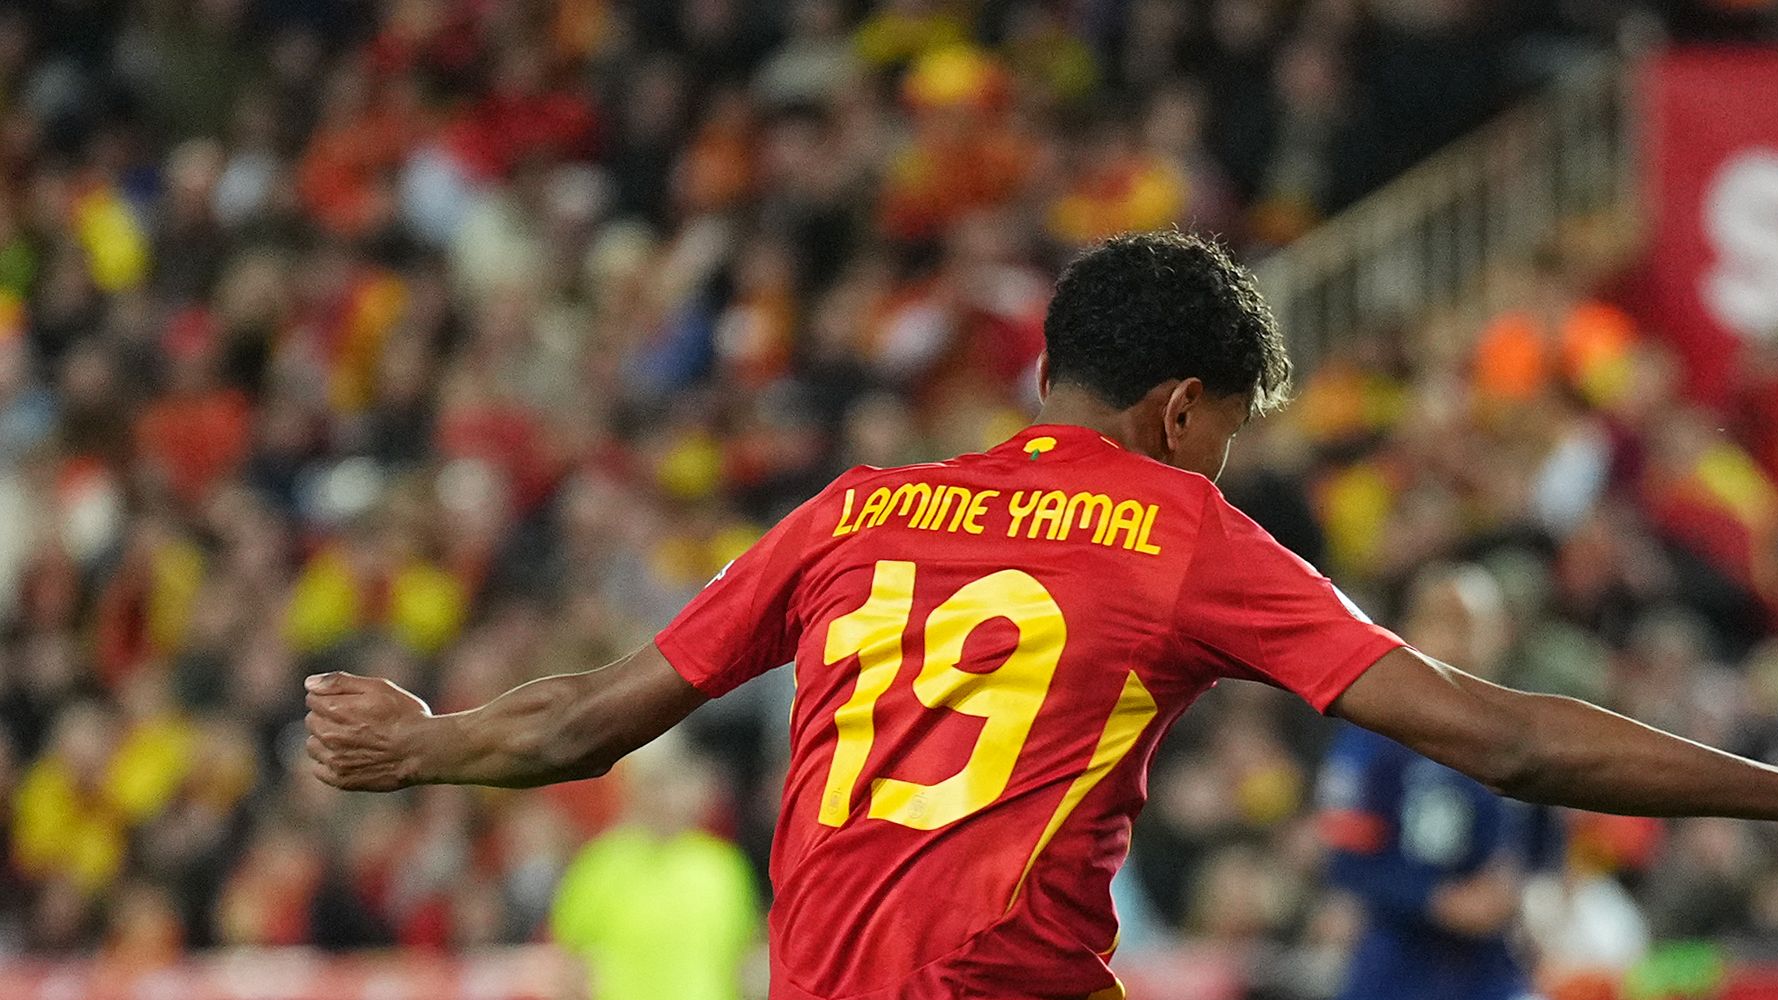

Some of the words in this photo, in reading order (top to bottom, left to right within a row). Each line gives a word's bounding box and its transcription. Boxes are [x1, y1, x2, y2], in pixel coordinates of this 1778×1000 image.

[832, 482, 1000, 538] LAMINE
[1007, 490, 1162, 556] YAMAL
[818, 560, 1068, 831] 19
